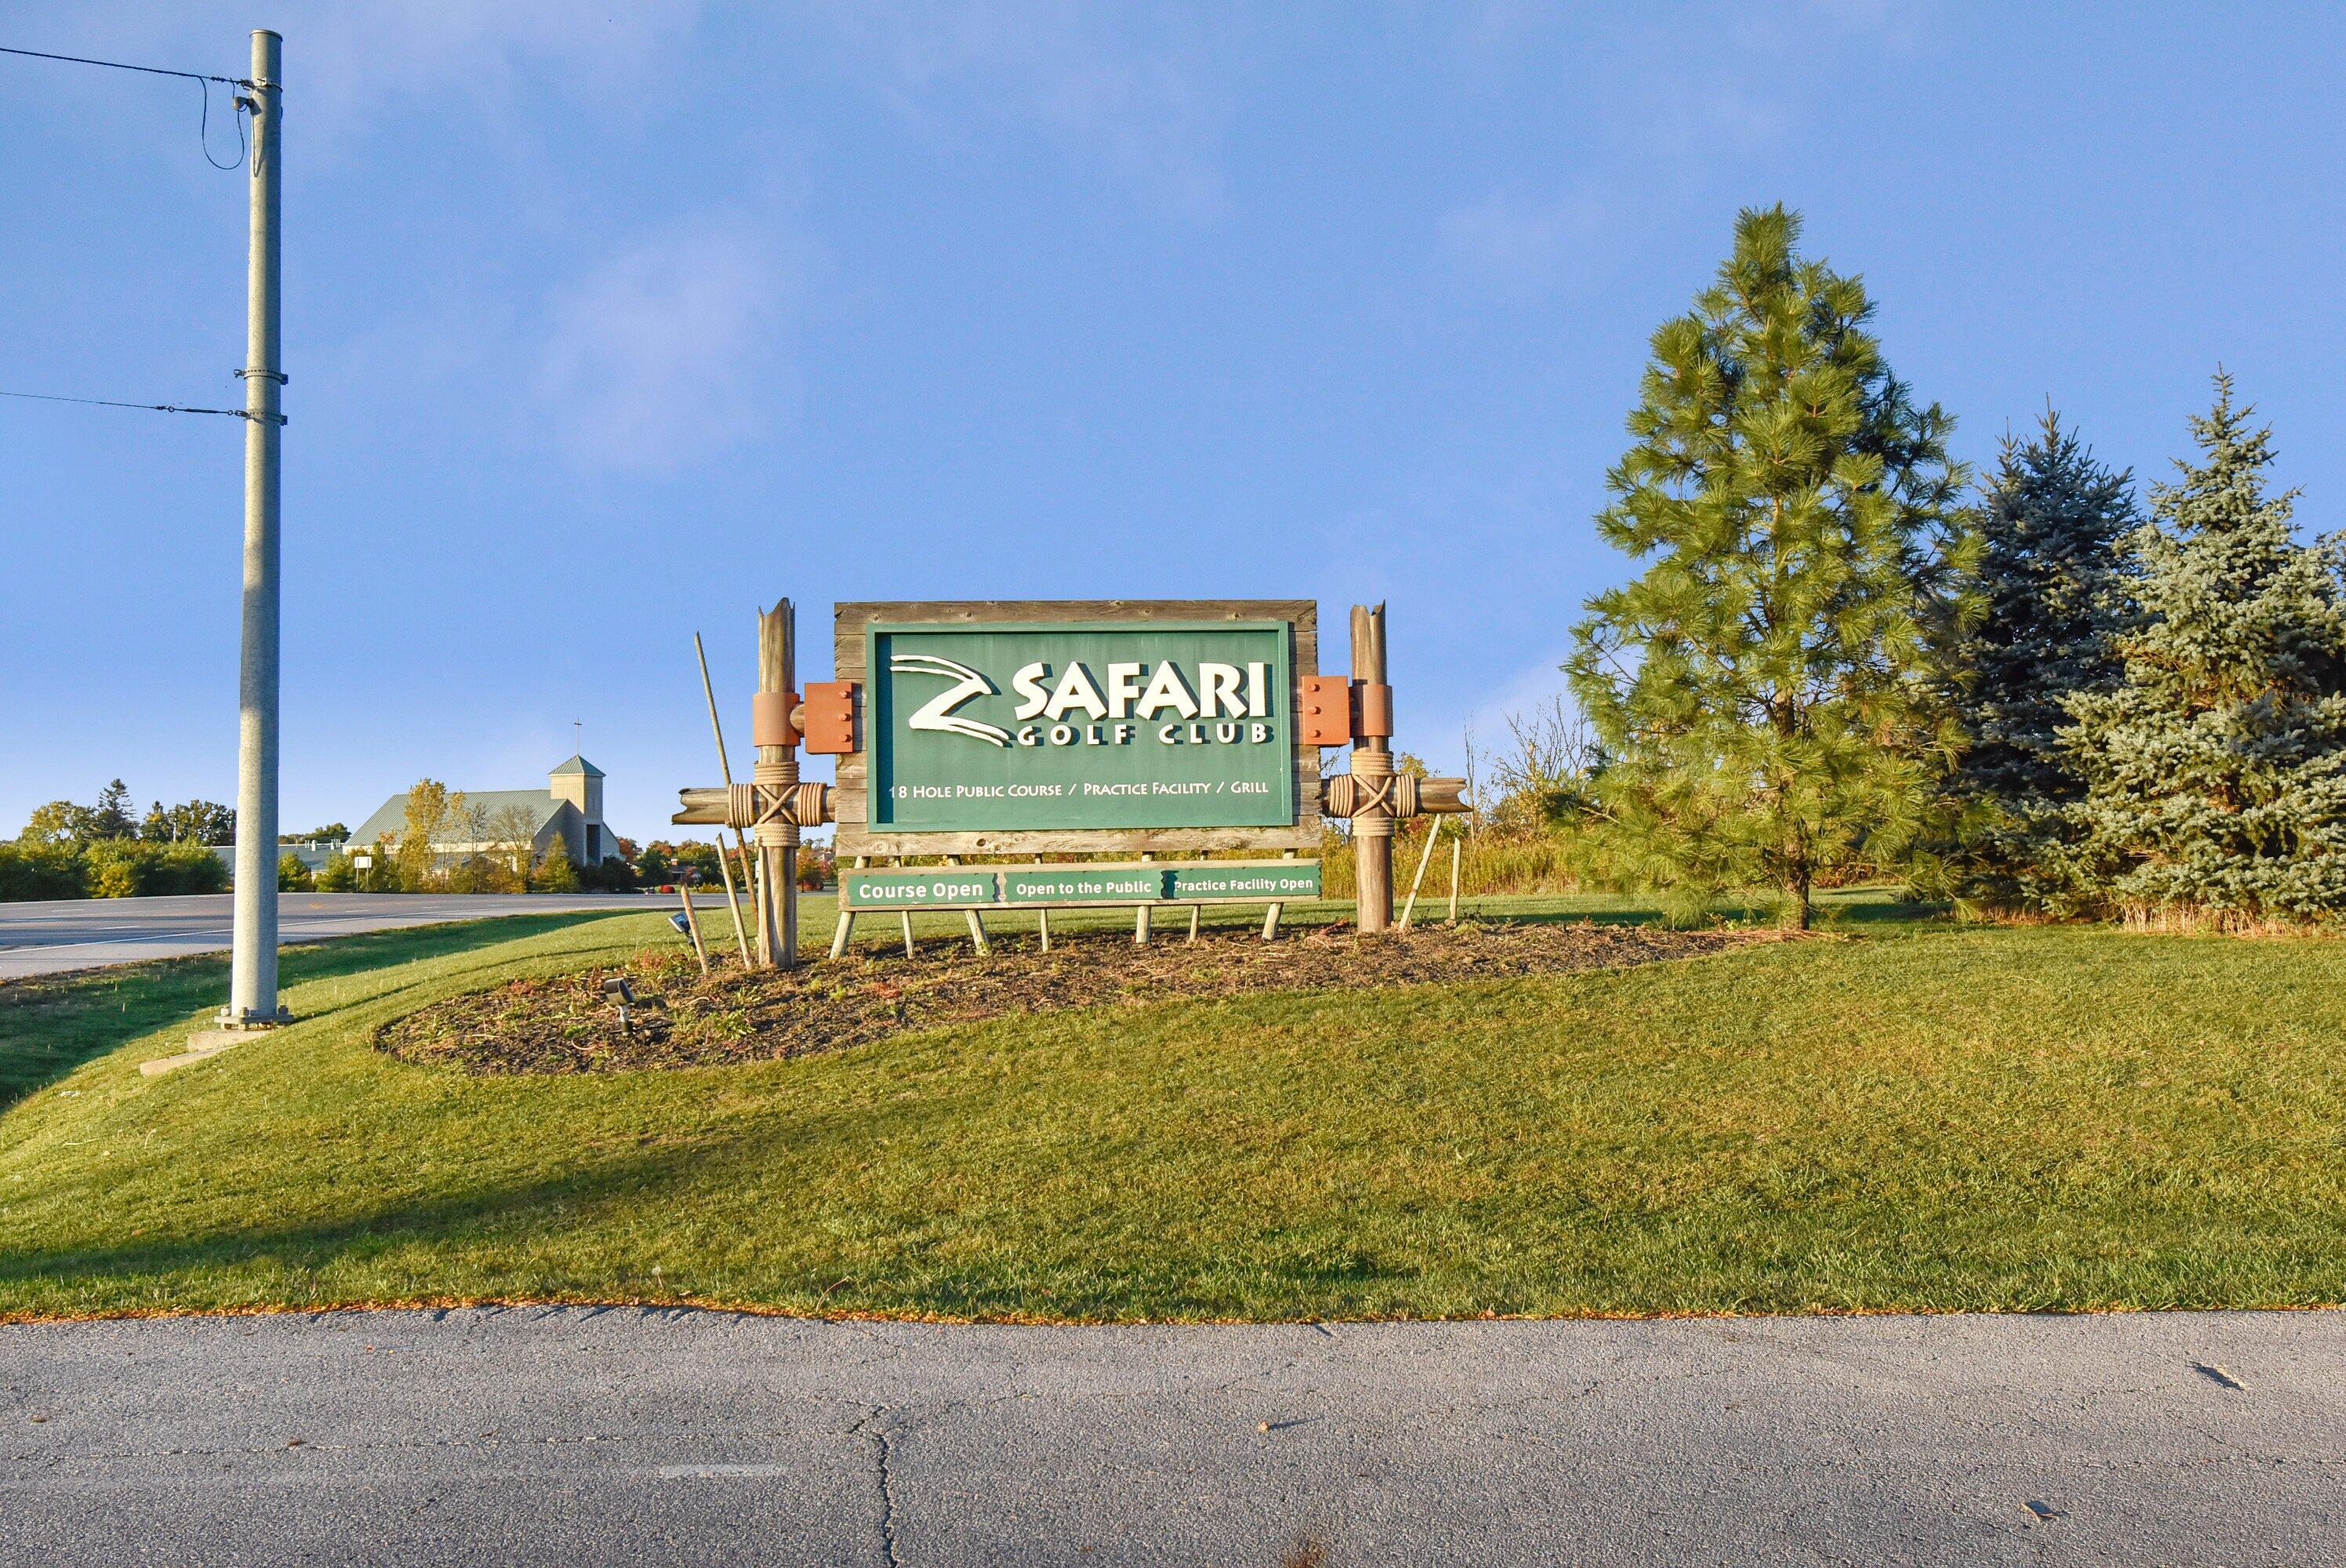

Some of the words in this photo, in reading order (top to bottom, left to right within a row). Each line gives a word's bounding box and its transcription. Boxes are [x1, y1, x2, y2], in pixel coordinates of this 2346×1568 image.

[1012, 660, 1266, 721] SAFARI
[1017, 724, 1127, 745] GOLF
[1158, 723, 1266, 744] CLUB
[889, 786, 907, 798] 18
[913, 786, 951, 798] HOLE
[957, 785, 1004, 797] PUBLIC
[1008, 784, 1062, 797] COURSE
[1084, 783, 1147, 795] PRACTICE
[1153, 782, 1211, 794] FACILITY
[1230, 781, 1269, 793] GRILL
[859, 884, 927, 898] Course
[932, 883, 982, 900] Open
[1016, 884, 1055, 897] Open
[1059, 883, 1073, 894] to
[1077, 882, 1102, 894] the
[1106, 880, 1152, 893] Public
[1174, 880, 1226, 891] Practice
[1230, 878, 1276, 891] Facility
[1280, 878, 1313, 891] Open
